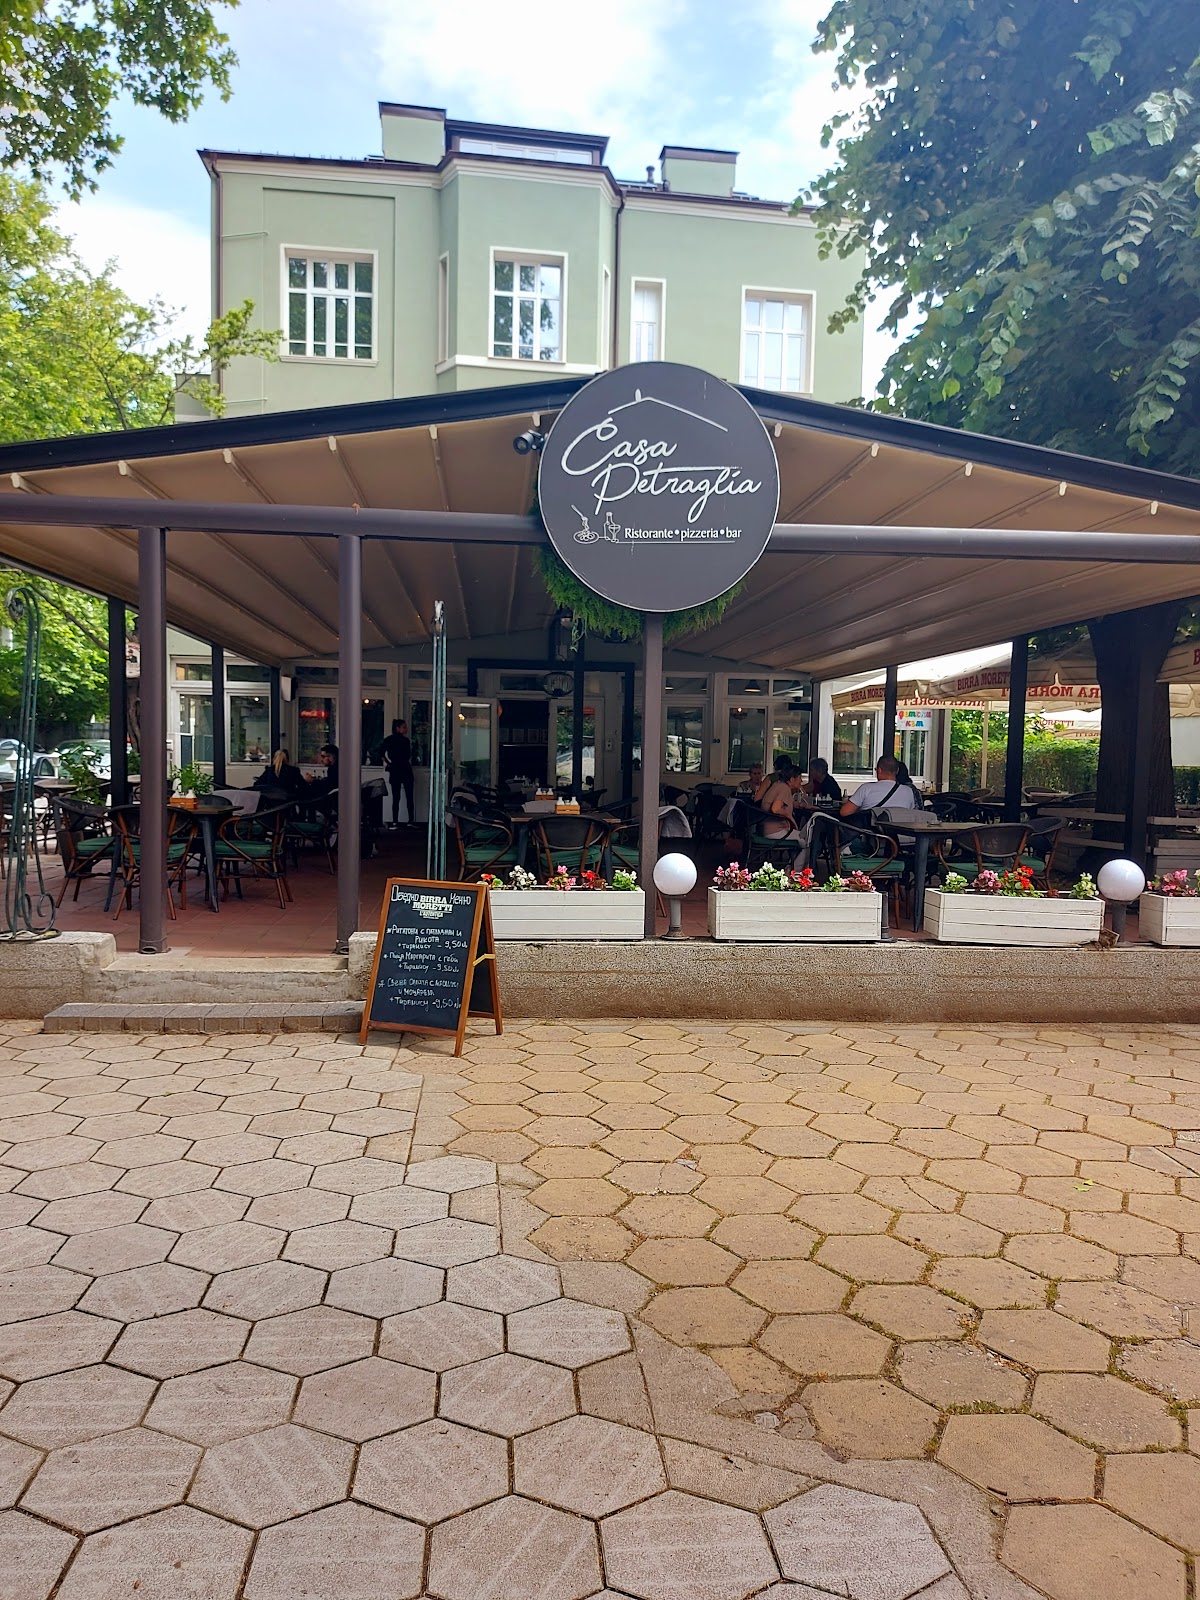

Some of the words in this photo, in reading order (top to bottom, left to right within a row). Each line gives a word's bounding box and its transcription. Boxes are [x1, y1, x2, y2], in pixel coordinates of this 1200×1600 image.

[561, 417, 677, 475] Casa
[591, 463, 762, 523] Petraglia
[624, 528, 673, 538] Ristorante
[681, 528, 719, 543] pizzeria
[726, 527, 742, 538] bar
[957, 675, 979, 690] BIRRA
[981, 671, 1011, 686] MORET
[412, 902, 453, 912] MORETTI
[420, 895, 447, 904] BIRRA
